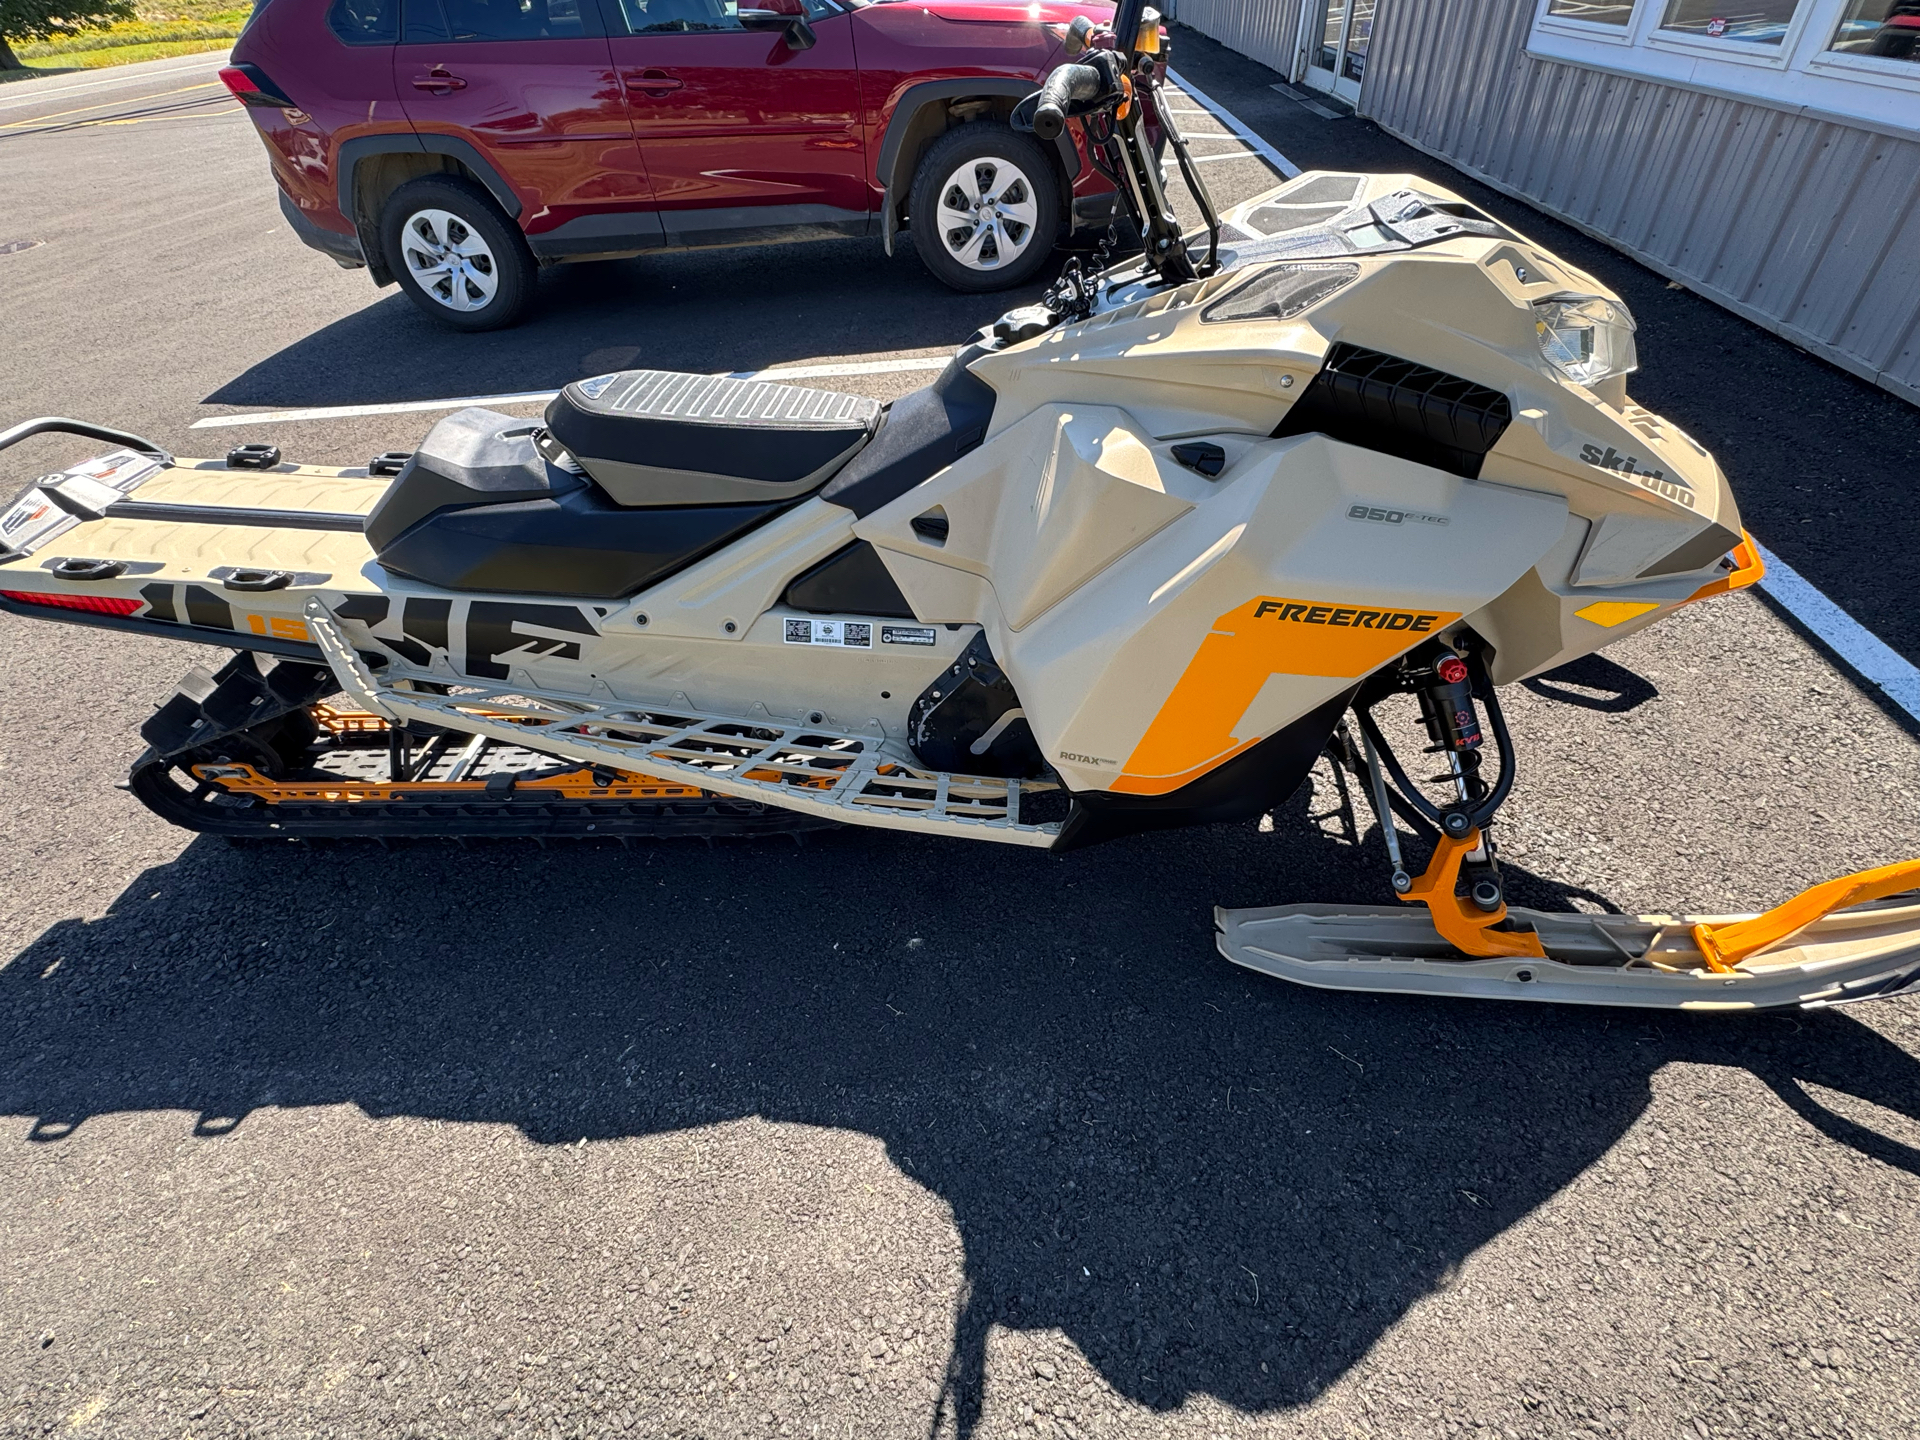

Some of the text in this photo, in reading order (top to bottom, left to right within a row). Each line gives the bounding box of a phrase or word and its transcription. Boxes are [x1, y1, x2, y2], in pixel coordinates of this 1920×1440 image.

[1580, 443, 1695, 508] ski-doo
[1348, 505, 1405, 523] 850
[247, 614, 316, 642] 15
[1254, 601, 1438, 632] FREERIDE
[1060, 751, 1100, 766] ROTAX
